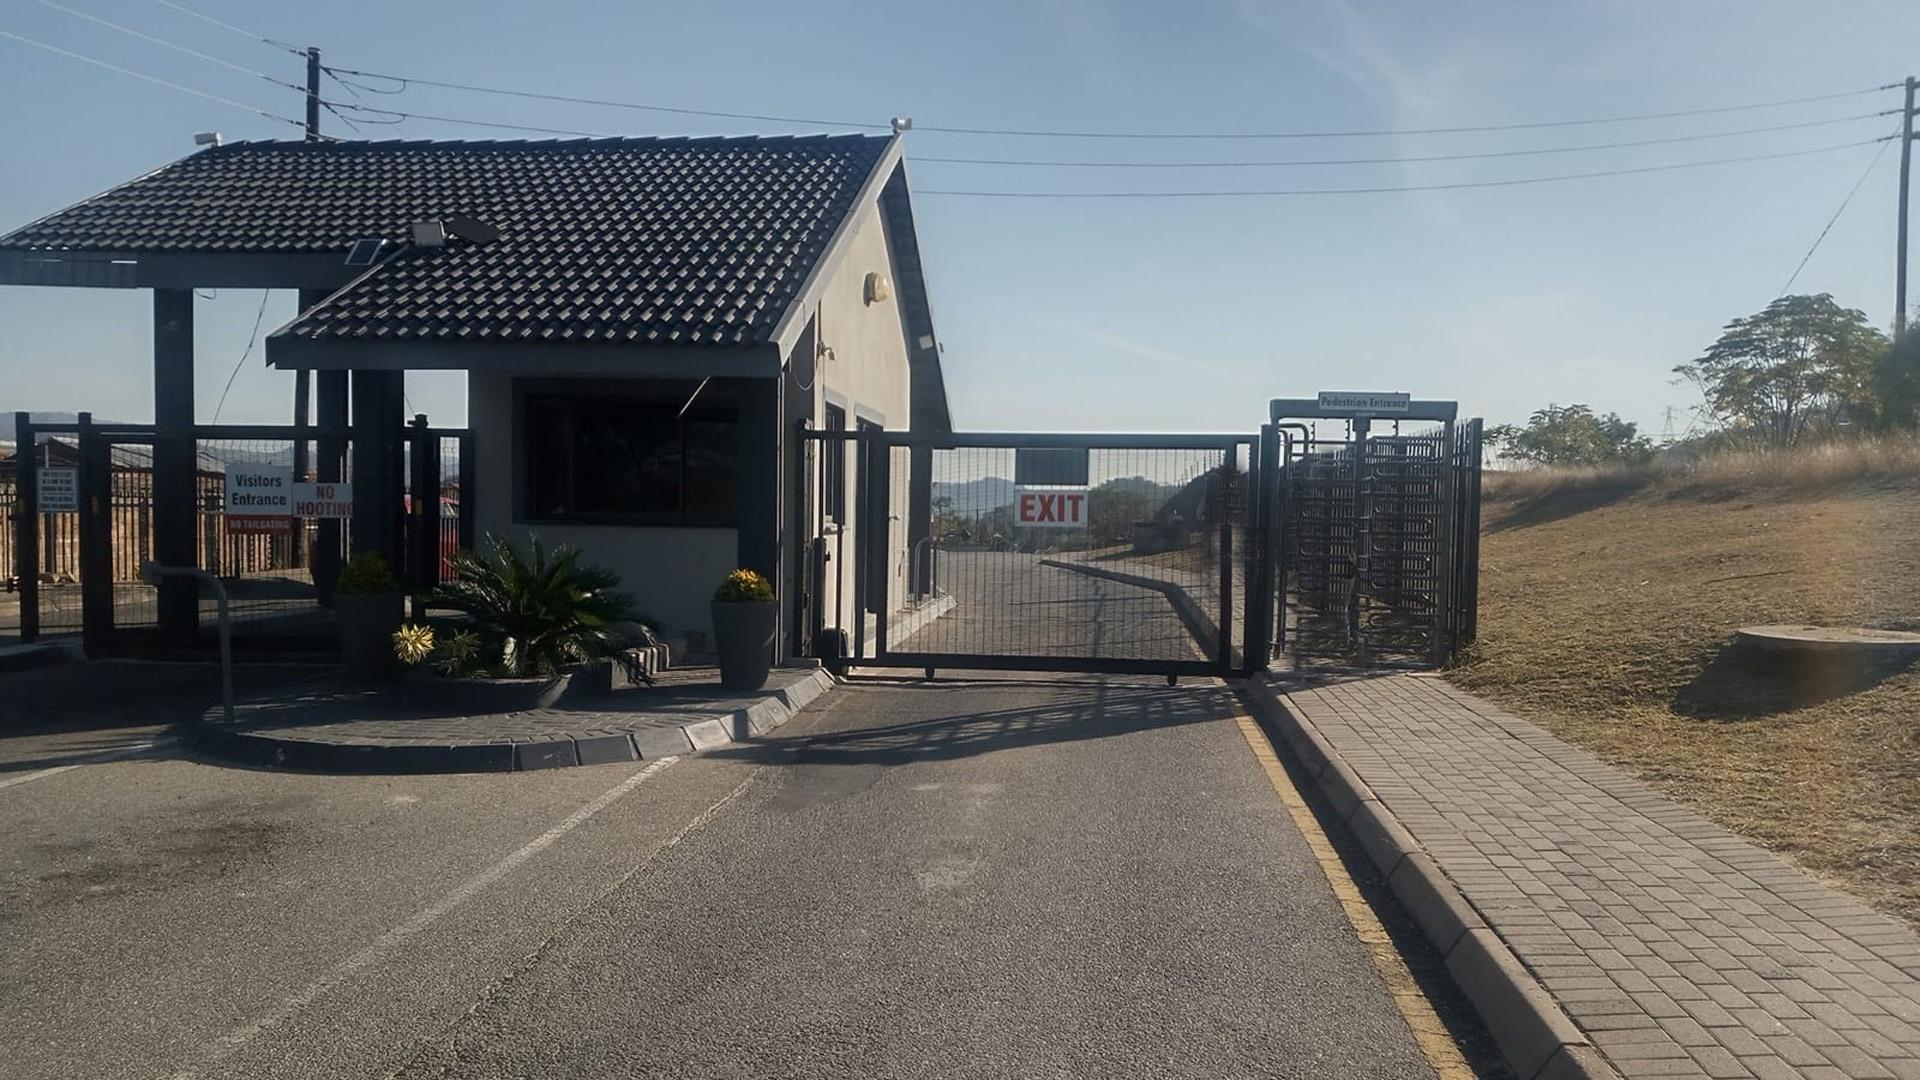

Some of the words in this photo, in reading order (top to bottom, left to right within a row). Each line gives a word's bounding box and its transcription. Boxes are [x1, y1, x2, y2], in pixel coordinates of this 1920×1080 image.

[1369, 398, 1407, 408] Entrance
[235, 474, 282, 488] Visitors
[231, 492, 287, 506] Entrance
[316, 485, 335, 499] NO
[1020, 494, 1084, 522] EXIT
[229, 520, 242, 529] NO
[243, 520, 289, 529] TAILGATING
